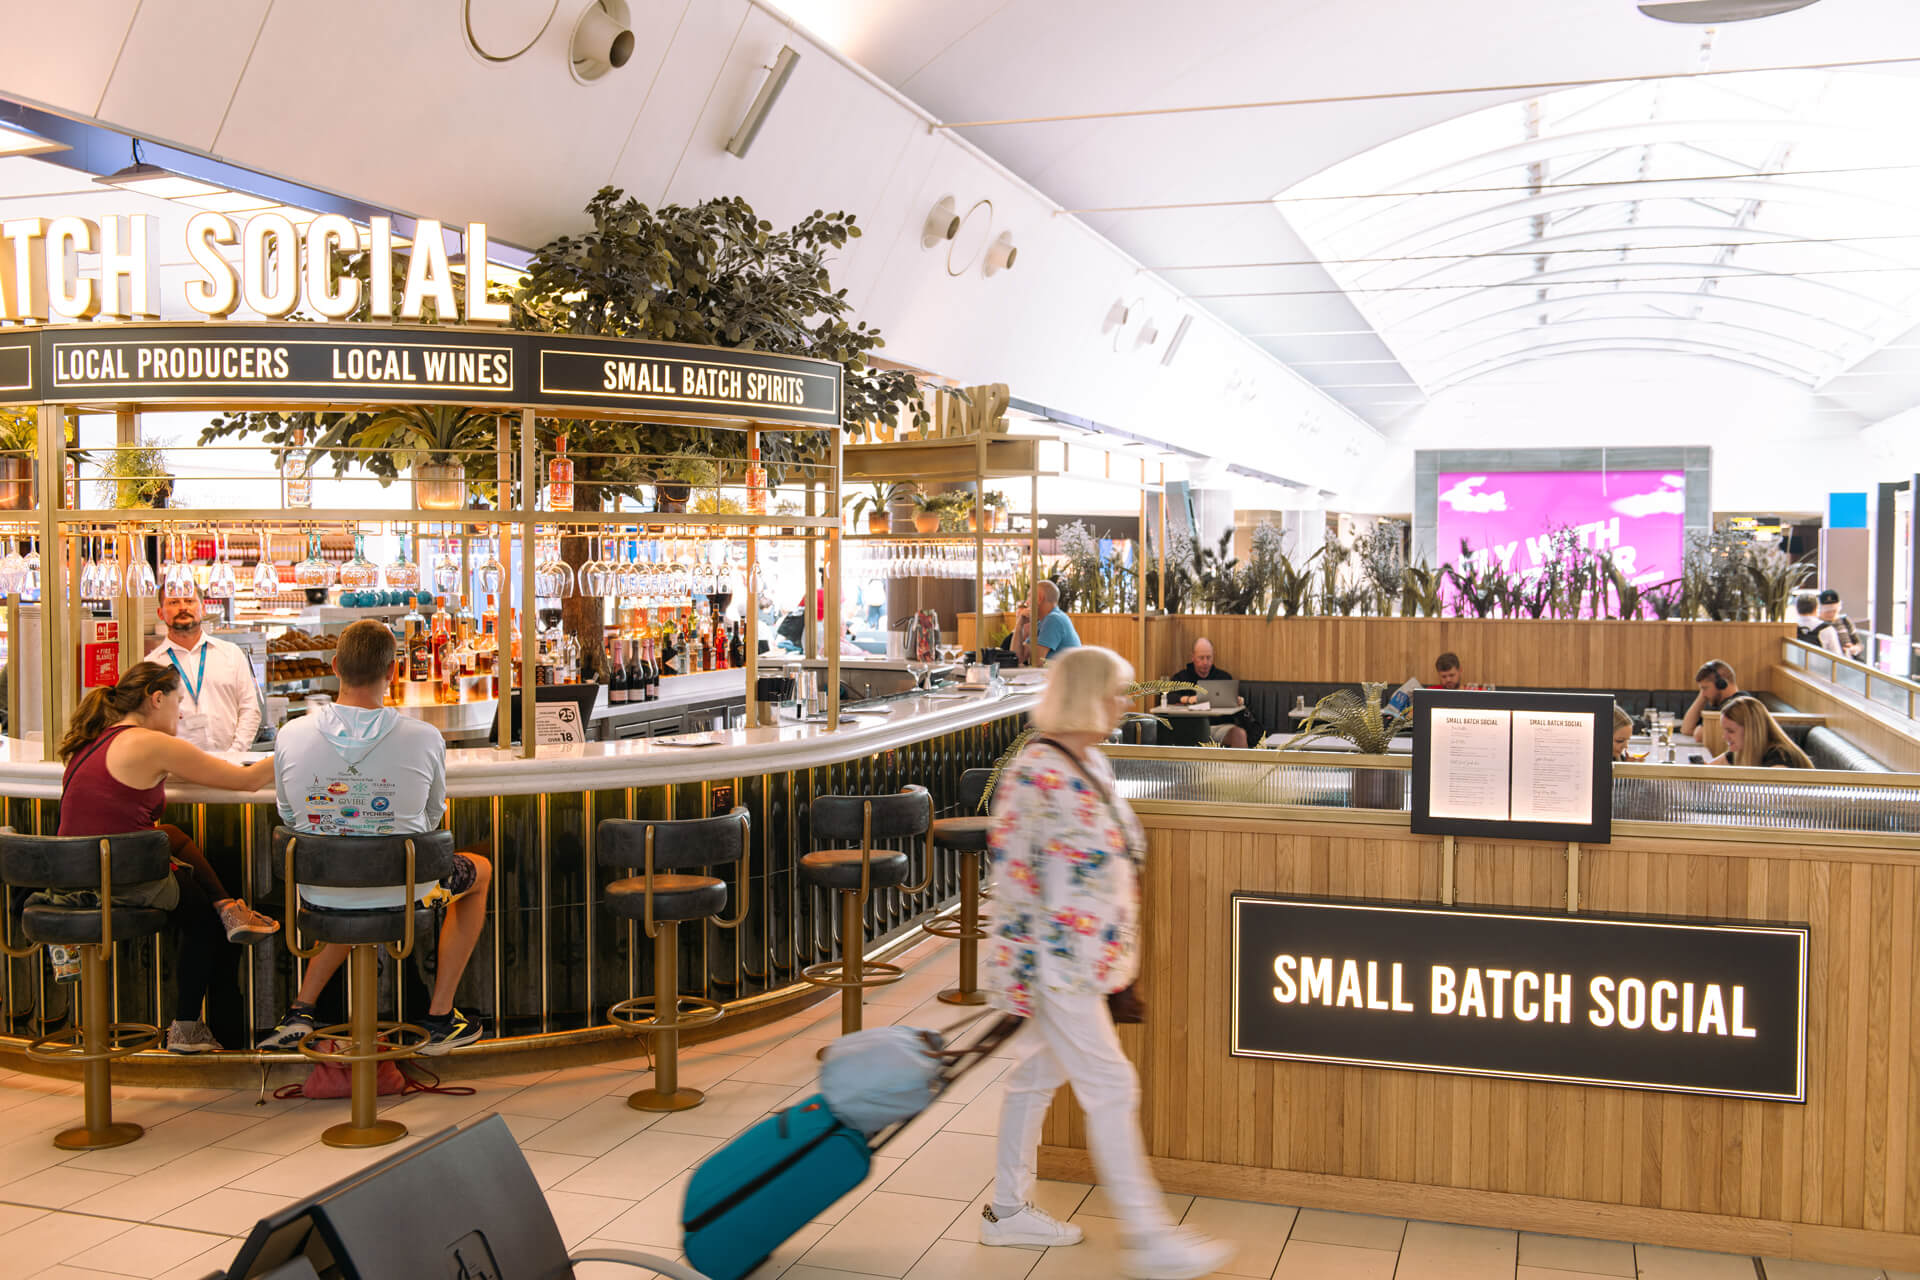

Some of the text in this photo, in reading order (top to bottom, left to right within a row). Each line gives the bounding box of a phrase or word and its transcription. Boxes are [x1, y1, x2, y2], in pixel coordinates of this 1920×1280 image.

[0, 211, 511, 323] TCH SOCIAL
[57, 347, 290, 381] LOCAL PRODUCERS
[332, 348, 509, 385] LOCAL WINES
[603, 360, 804, 406] SMALL BATCH SPIRITS
[559, 710, 574, 721] 25
[1446, 717, 1462, 725] SMALL
[1480, 718, 1498, 726] SOCIAL
[1547, 719, 1564, 727] BATCH
[1564, 720, 1583, 728] SOCIAL
[560, 732, 573, 742] 18
[1272, 954, 1756, 1038] SMALL BATCH SOCIAL
